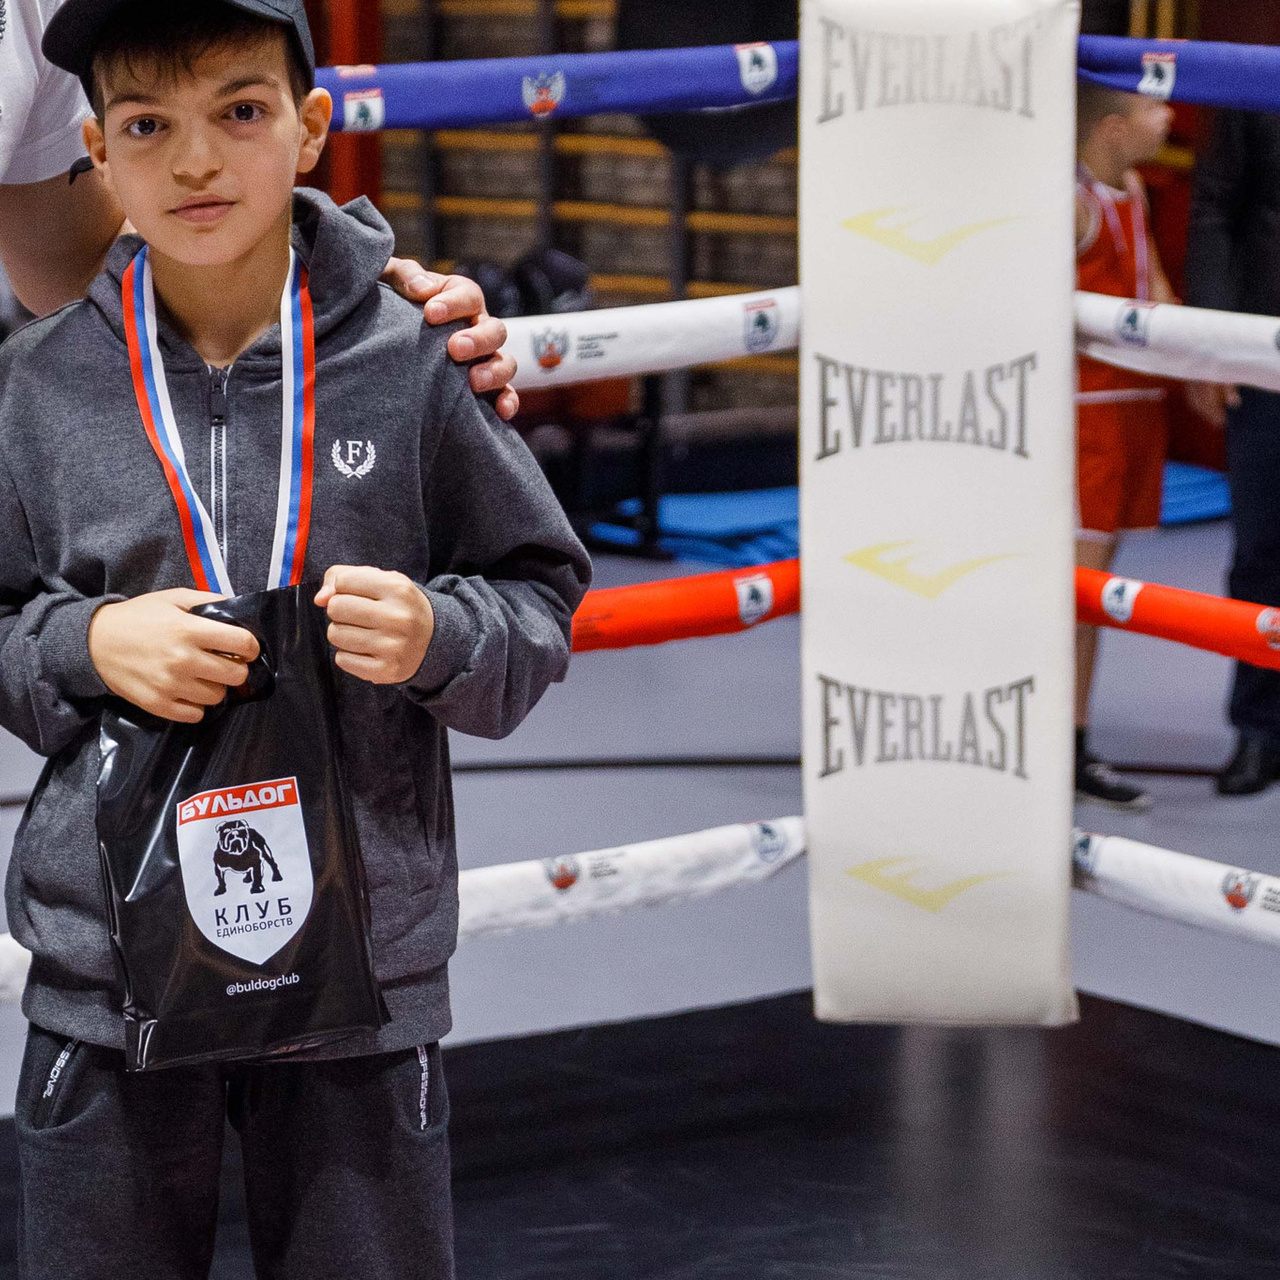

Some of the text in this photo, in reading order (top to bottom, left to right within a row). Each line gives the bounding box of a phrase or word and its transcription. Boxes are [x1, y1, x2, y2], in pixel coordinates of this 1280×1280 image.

[816, 15, 1038, 124] EVERLAST
[814, 353, 1038, 460] EVERLAST
[346, 440, 363, 464] F
[817, 675, 1036, 778] EVERLAST
[181, 782, 294, 821] БУЛЬДОГ
[214, 896, 293, 927] КЛУБ
[216, 916, 294, 939] ЕДИНОБОРСТВ
[225, 972, 301, 996] @buldogclub
